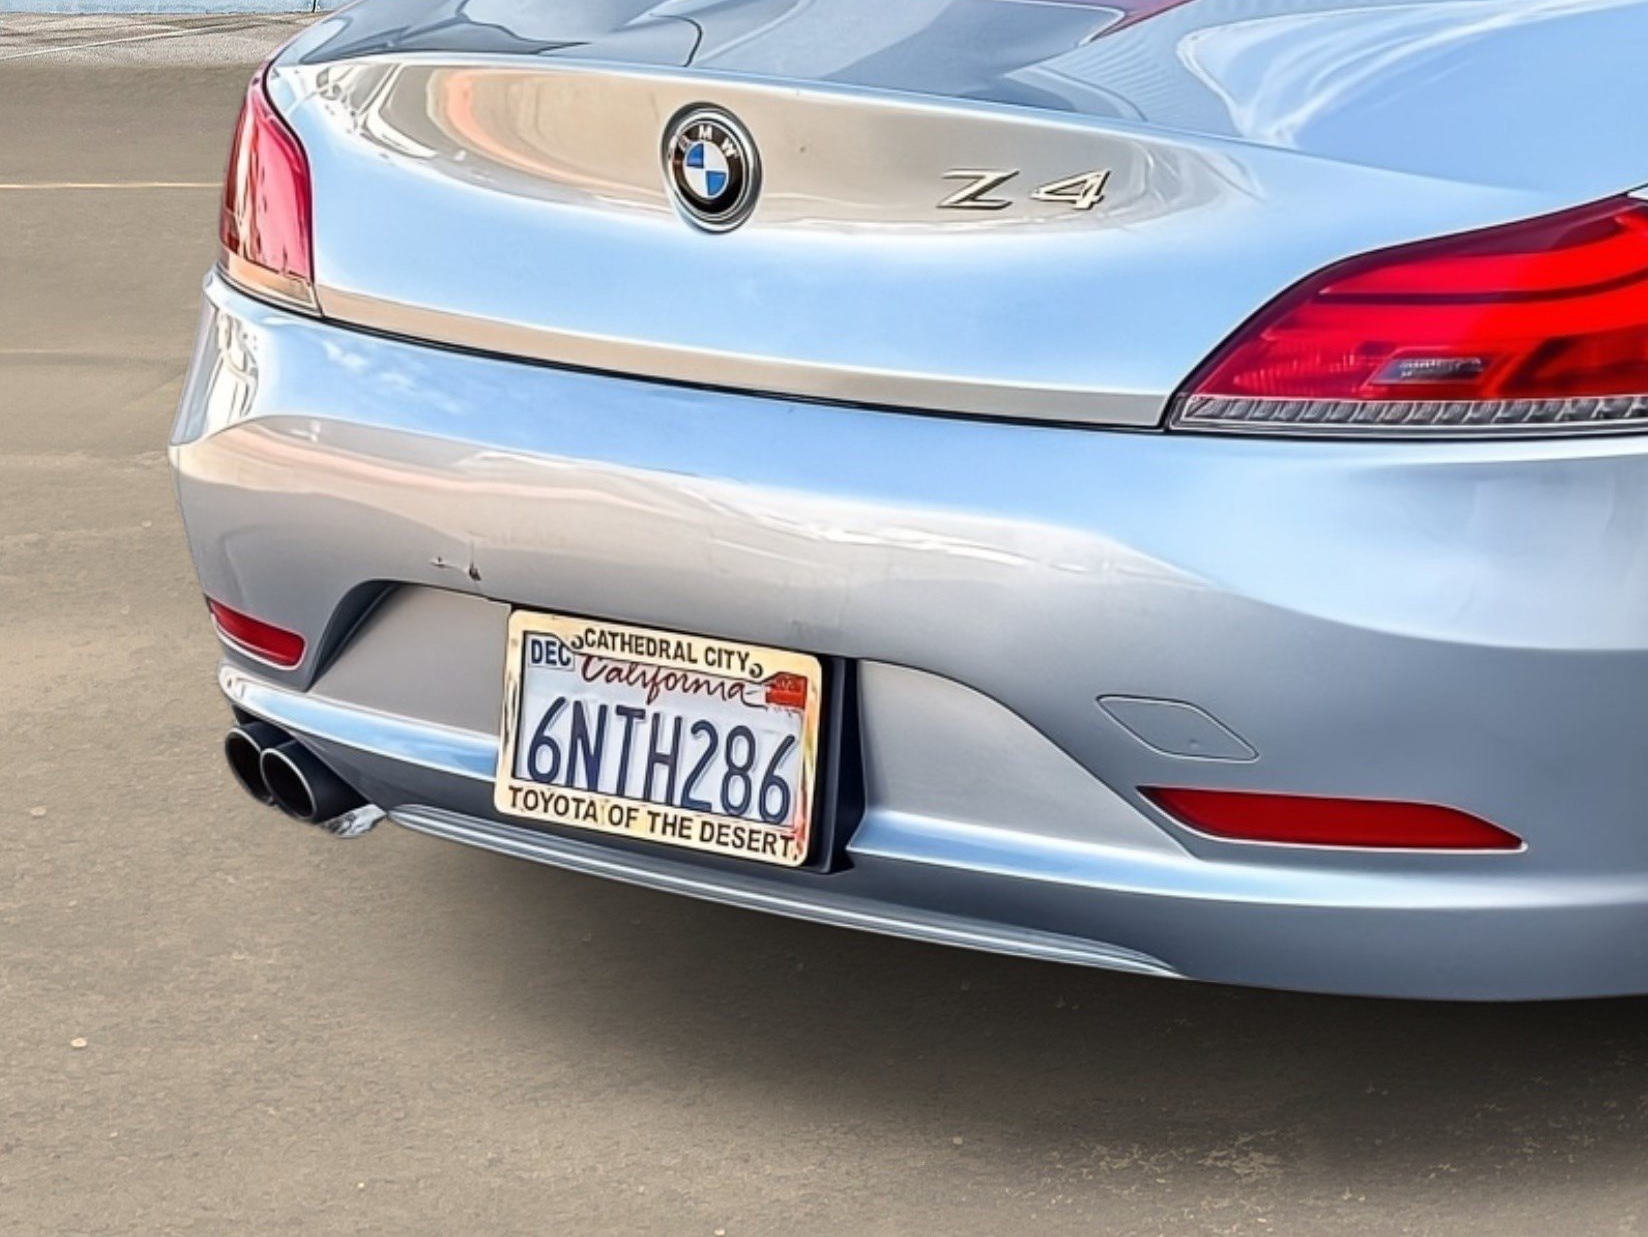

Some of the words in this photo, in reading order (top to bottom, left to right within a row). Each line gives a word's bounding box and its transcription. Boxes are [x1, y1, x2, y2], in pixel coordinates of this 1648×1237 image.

[530, 638, 572, 667] DEC
[584, 627, 698, 664] CATHEDRAL
[703, 646, 750, 671] CITY
[580, 654, 768, 705] California
[526, 696, 796, 827] 6NTH286
[508, 784, 598, 823] TOYOTA
[607, 802, 640, 828] OF
[647, 810, 693, 840] THE
[699, 820, 795, 858] DESERT
